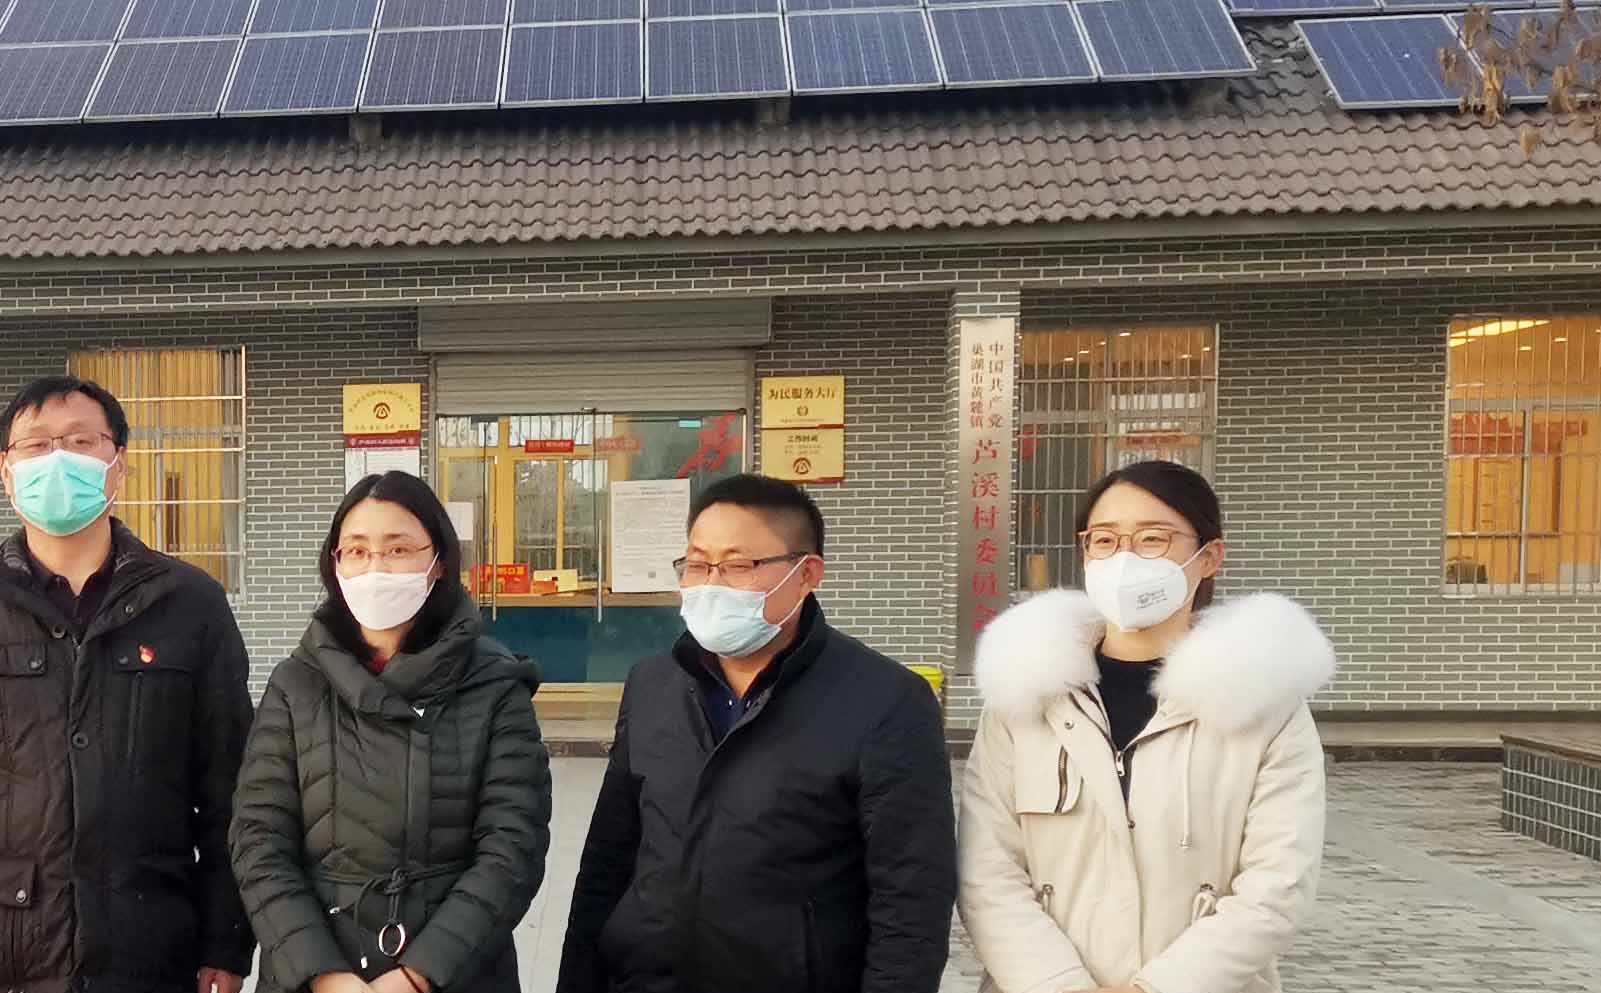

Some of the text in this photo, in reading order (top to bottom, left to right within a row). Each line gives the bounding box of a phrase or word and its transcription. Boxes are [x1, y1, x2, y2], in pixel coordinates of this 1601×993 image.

[768, 386, 836, 400] 为民服务大厅
[987, 341, 1004, 430] 中国共产党
